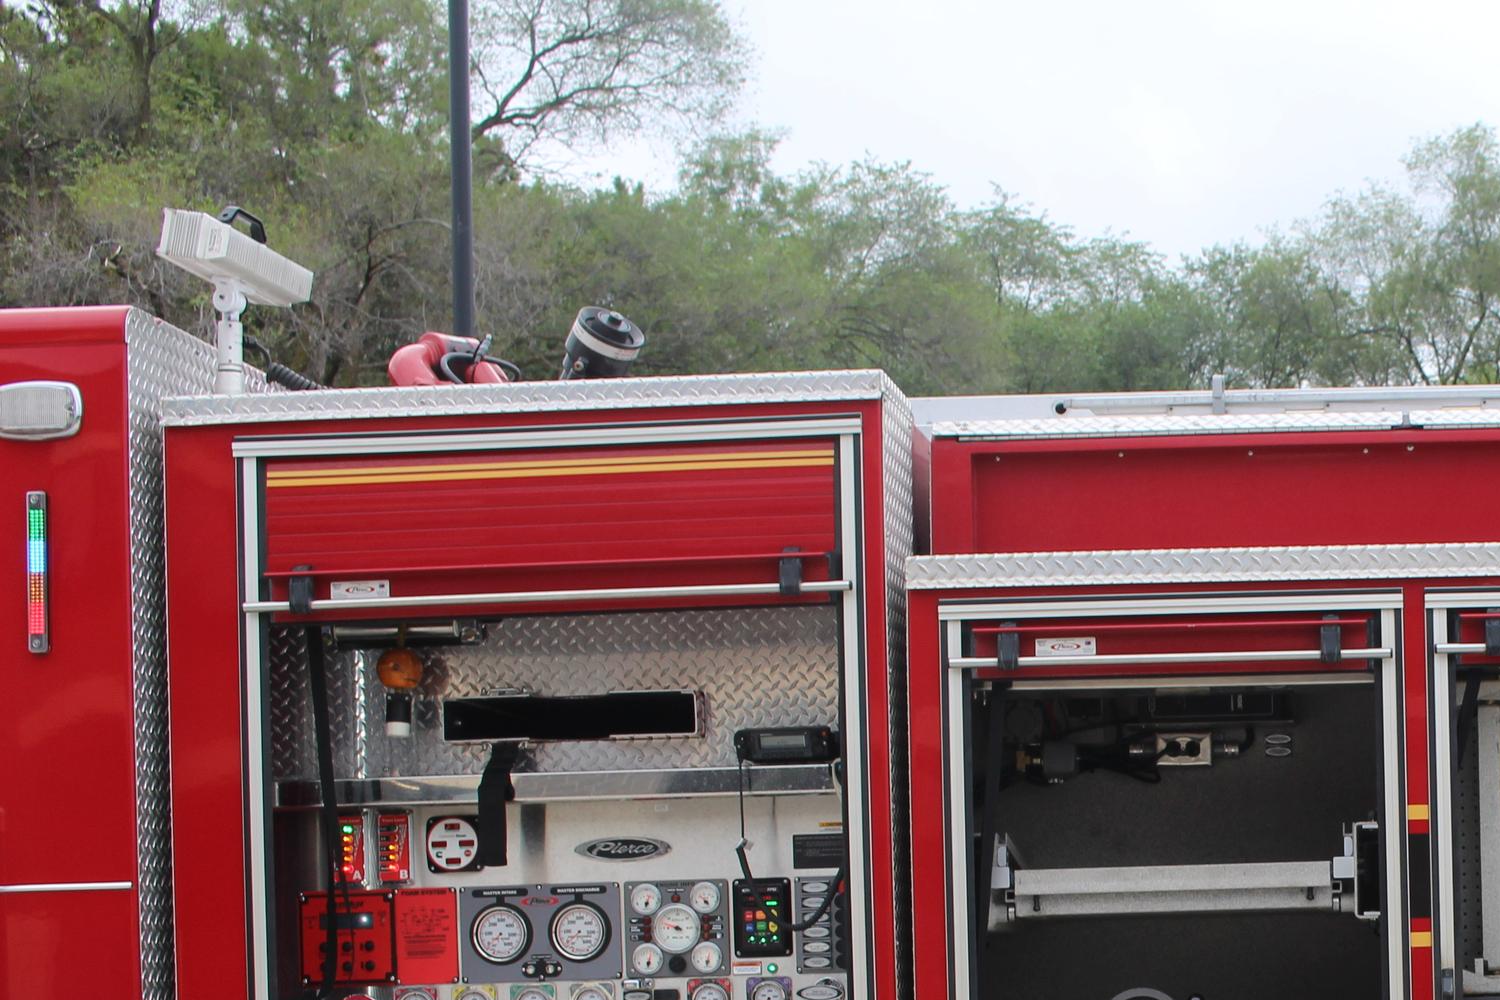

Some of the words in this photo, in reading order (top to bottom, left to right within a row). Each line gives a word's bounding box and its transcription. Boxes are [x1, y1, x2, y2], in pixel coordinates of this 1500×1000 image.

[592, 842, 655, 857] Pierce
[352, 870, 362, 880] A
[400, 870, 408, 879] B
